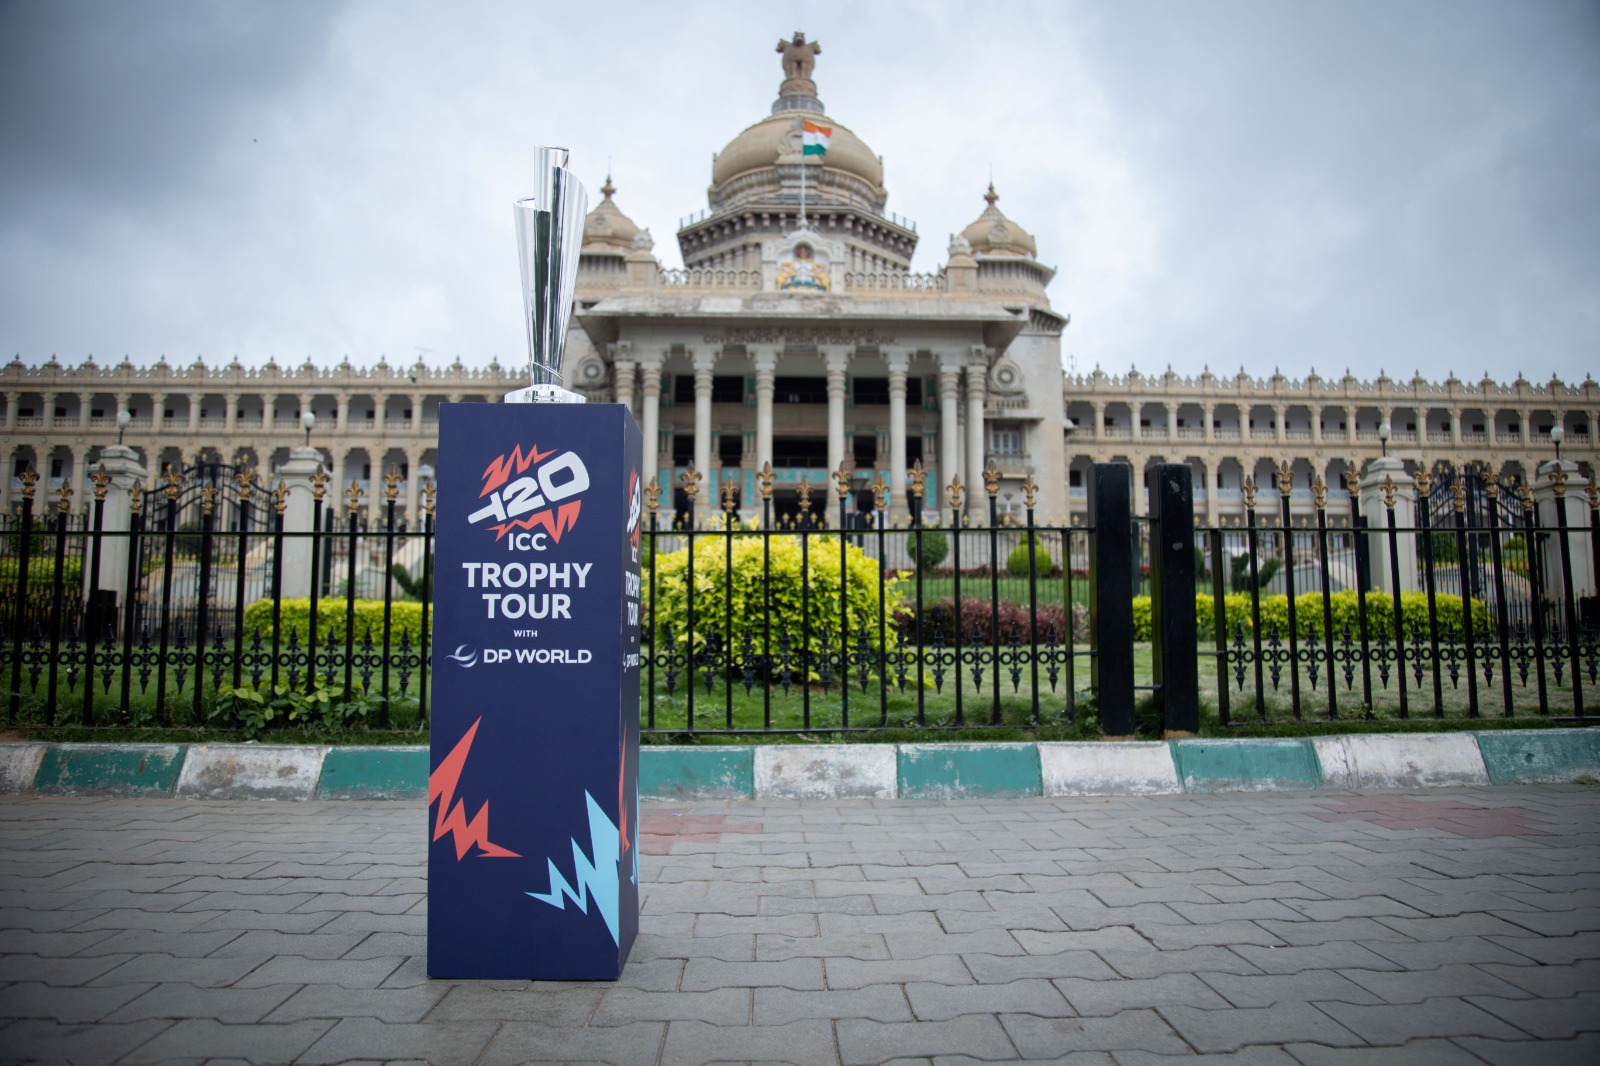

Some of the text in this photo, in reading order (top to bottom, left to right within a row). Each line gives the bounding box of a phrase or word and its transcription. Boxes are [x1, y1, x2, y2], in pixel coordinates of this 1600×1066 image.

[508, 533, 547, 551] ICC
[462, 562, 593, 588] TROPHY
[625, 570, 641, 599] TROPHY
[482, 593, 572, 619] TOUR
[627, 601, 639, 627] TOUR
[513, 629, 538, 638] WITH
[483, 648, 593, 664] DP WORLD
